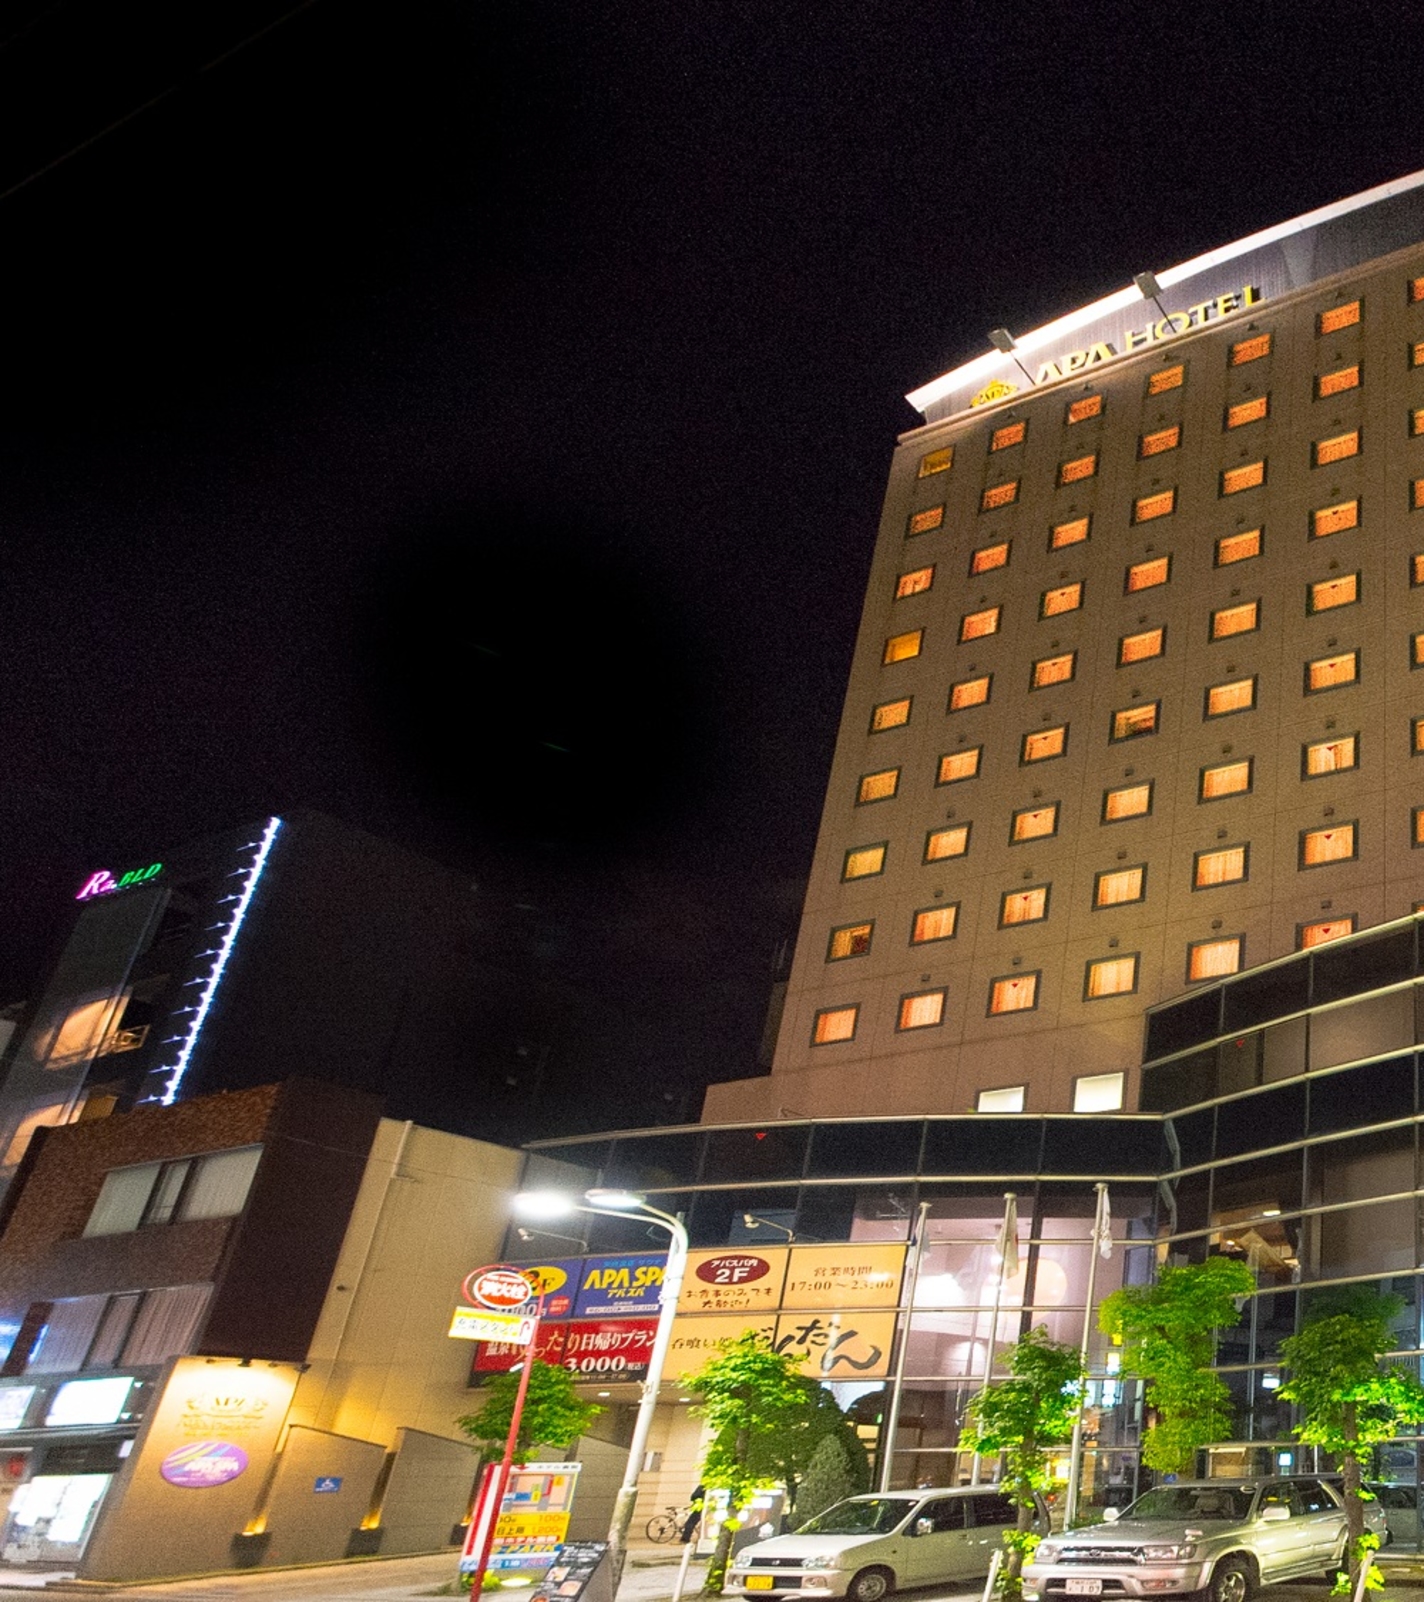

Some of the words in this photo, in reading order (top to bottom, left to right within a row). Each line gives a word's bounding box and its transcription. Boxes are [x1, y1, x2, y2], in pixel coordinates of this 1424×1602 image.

[1036, 341, 1114, 385] APA
[1124, 285, 1267, 352] HOTEL
[583, 1267, 630, 1290] APA
[714, 1267, 750, 1283] 2F
